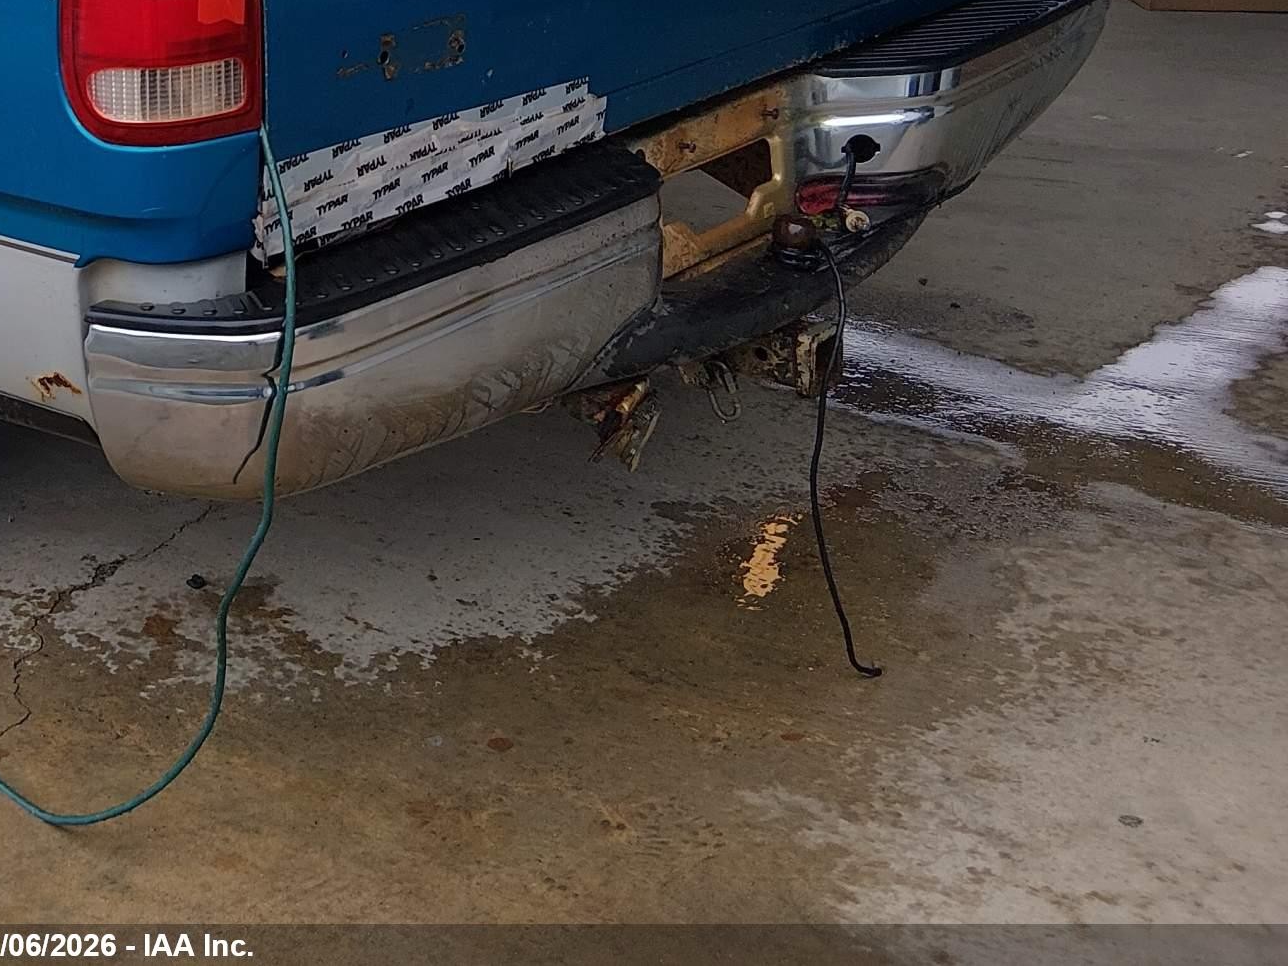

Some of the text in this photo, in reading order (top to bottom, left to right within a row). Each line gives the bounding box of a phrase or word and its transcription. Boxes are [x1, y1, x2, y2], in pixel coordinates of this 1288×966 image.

[432, 112, 460, 131] TYPAR
[557, 115, 580, 135] TYPAR
[384, 124, 411, 144] TYPAR
[515, 130, 539, 151] TYPAR
[332, 138, 361, 159] TYPAR
[409, 141, 438, 161] TYPAR
[469, 146, 495, 167] TYPAR
[357, 155, 387, 177] TYPAR
[421, 162, 449, 183] TYPAR
[303, 169, 334, 193] TYPAR
[372, 178, 401, 201] TYPAR
[316, 194, 348, 216] TYPAR
[395, 194, 424, 215] TYPAR
